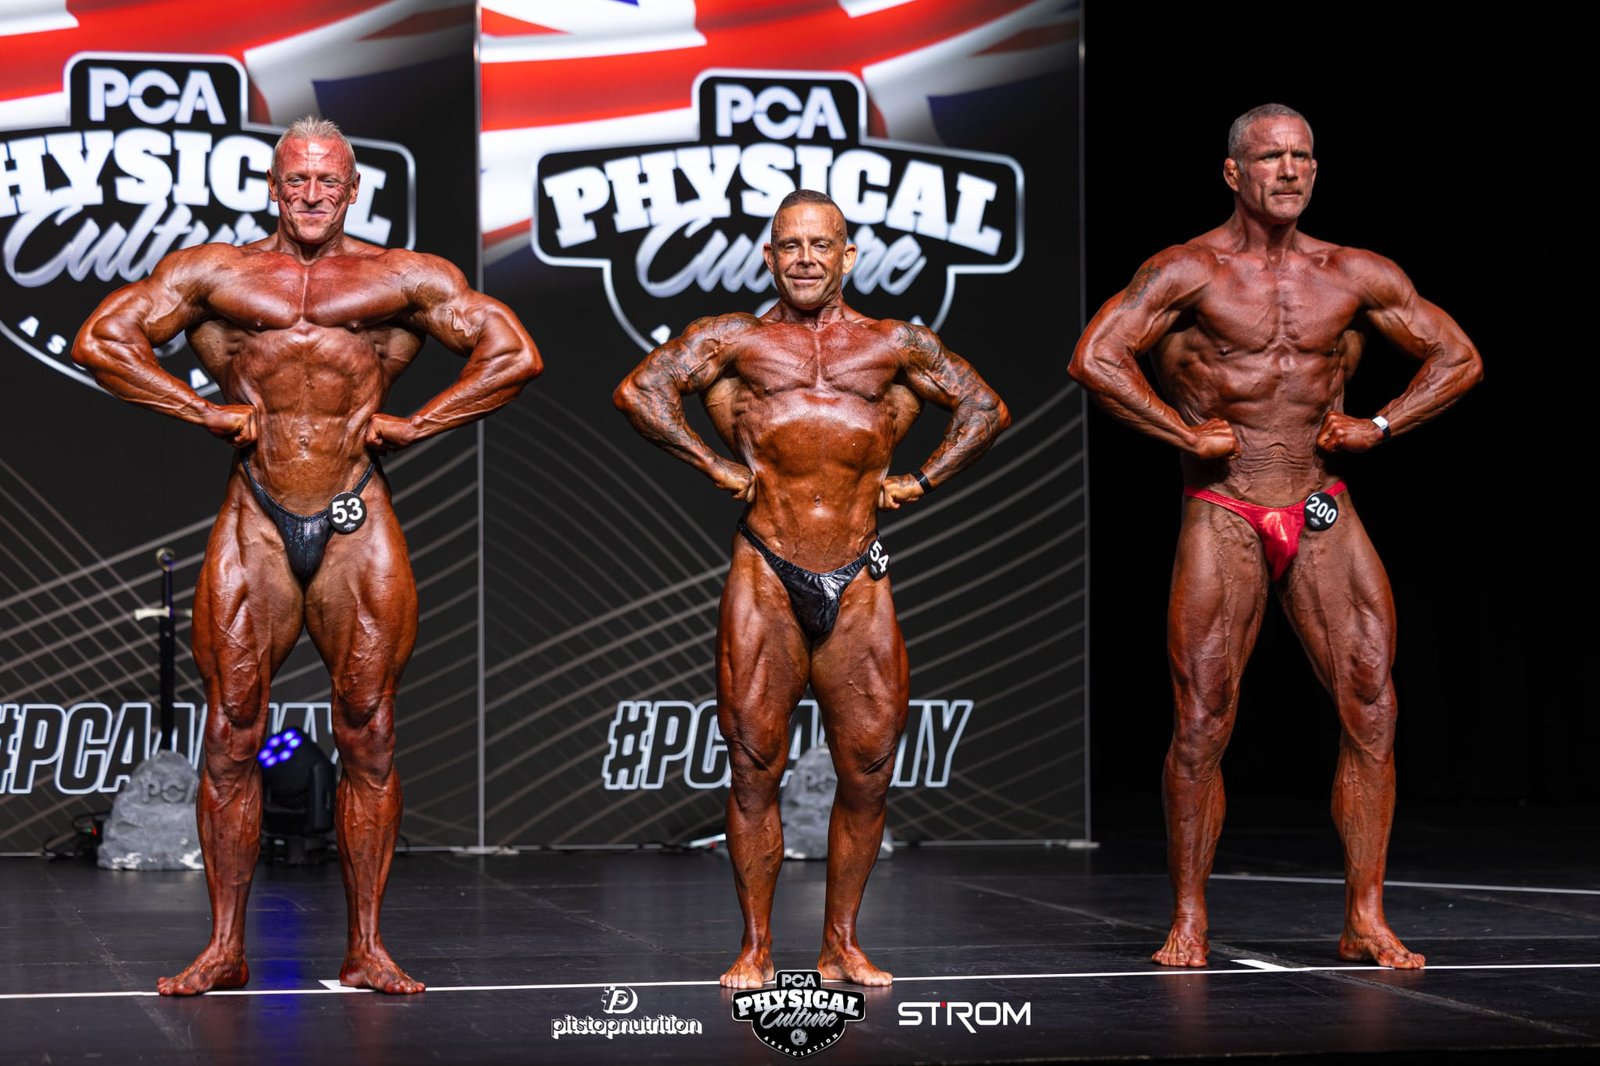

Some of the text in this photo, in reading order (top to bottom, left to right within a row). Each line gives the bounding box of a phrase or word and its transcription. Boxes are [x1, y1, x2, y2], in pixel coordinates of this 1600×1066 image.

[88, 66, 227, 125] PCA
[714, 83, 847, 140] PCA
[0, 128, 392, 244] HYSICL
[635, 206, 927, 298] Culre
[332, 497, 363, 524] 53
[1305, 496, 1337, 524] 200
[870, 540, 889, 573] 54
